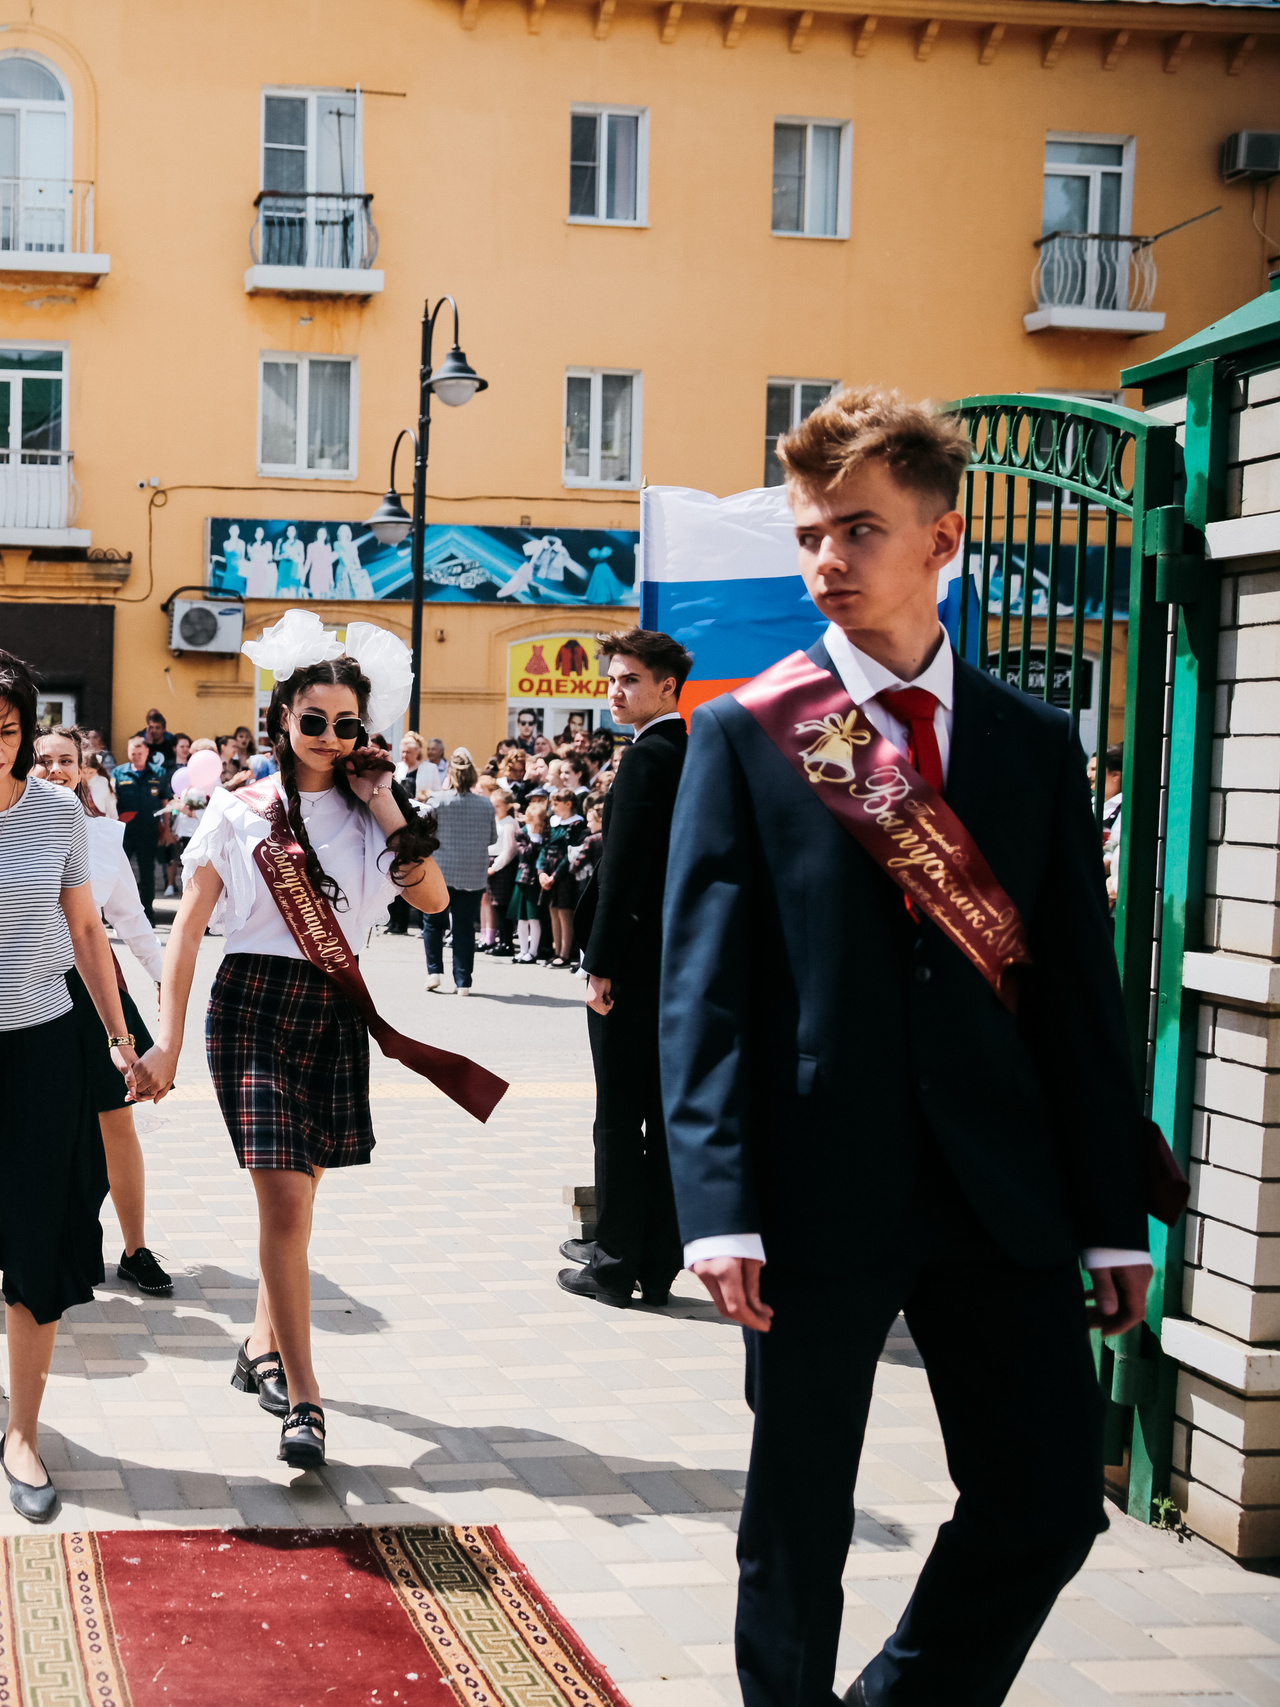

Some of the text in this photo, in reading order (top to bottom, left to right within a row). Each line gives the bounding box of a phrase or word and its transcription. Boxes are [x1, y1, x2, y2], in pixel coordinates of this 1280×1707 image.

[518, 678, 609, 697] ОДЕЖД
[266, 832, 329, 942] Выпускница
[314, 936, 349, 972] 2023
[849, 765, 986, 930] Выпускник
